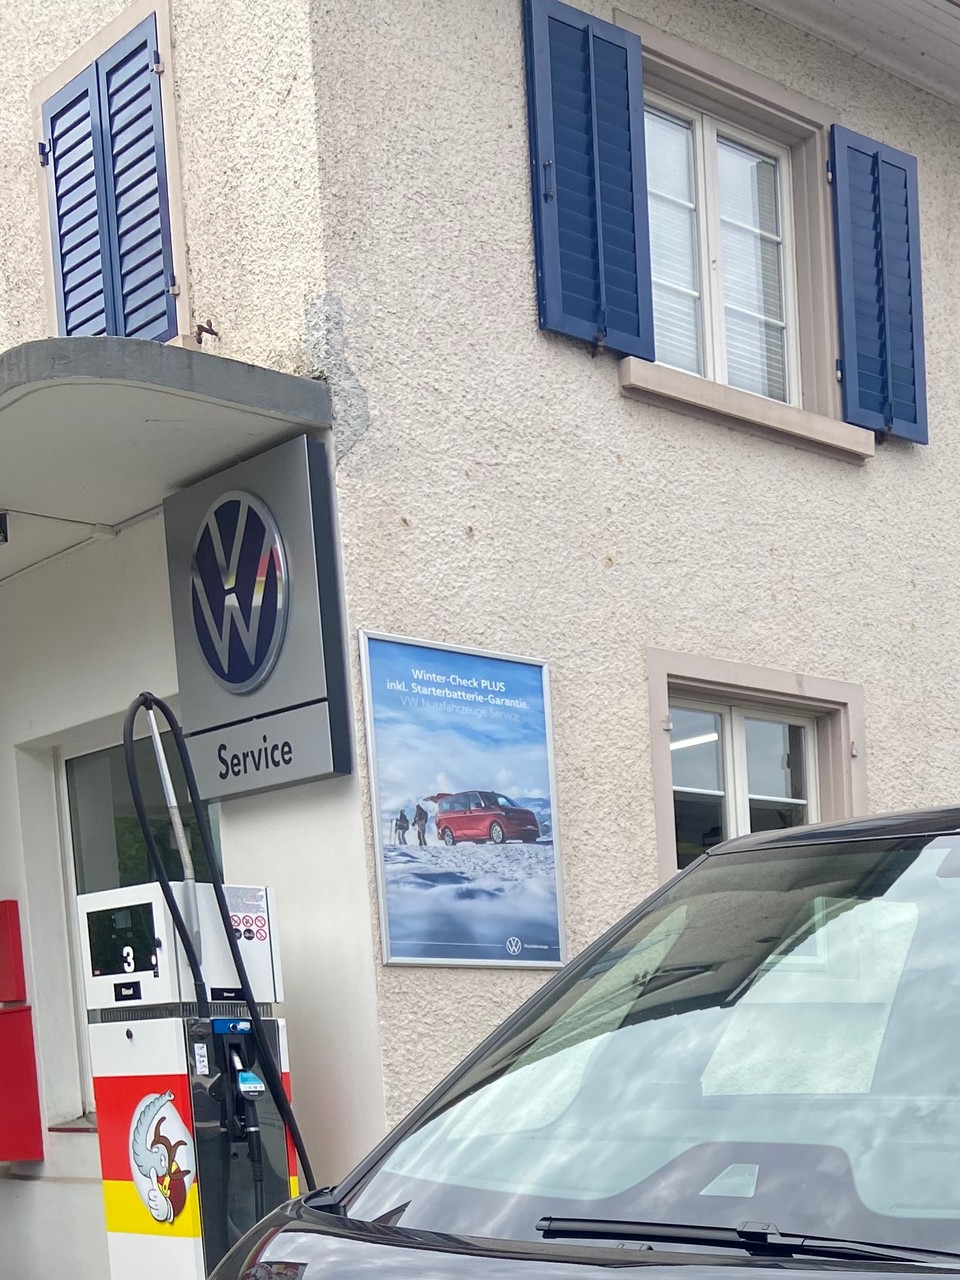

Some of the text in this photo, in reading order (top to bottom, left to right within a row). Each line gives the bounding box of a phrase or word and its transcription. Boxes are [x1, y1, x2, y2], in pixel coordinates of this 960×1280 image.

[192, 496, 284, 685] VW
[386, 679, 530, 709] inkl. Starterbatterie-Garantie.
[411, 669, 506, 693] Winter-Check PLUS
[400, 696, 520, 722] VW Nutzfahrzeuge Service
[217, 734, 292, 780] Service
[122, 946, 135, 973] 3
